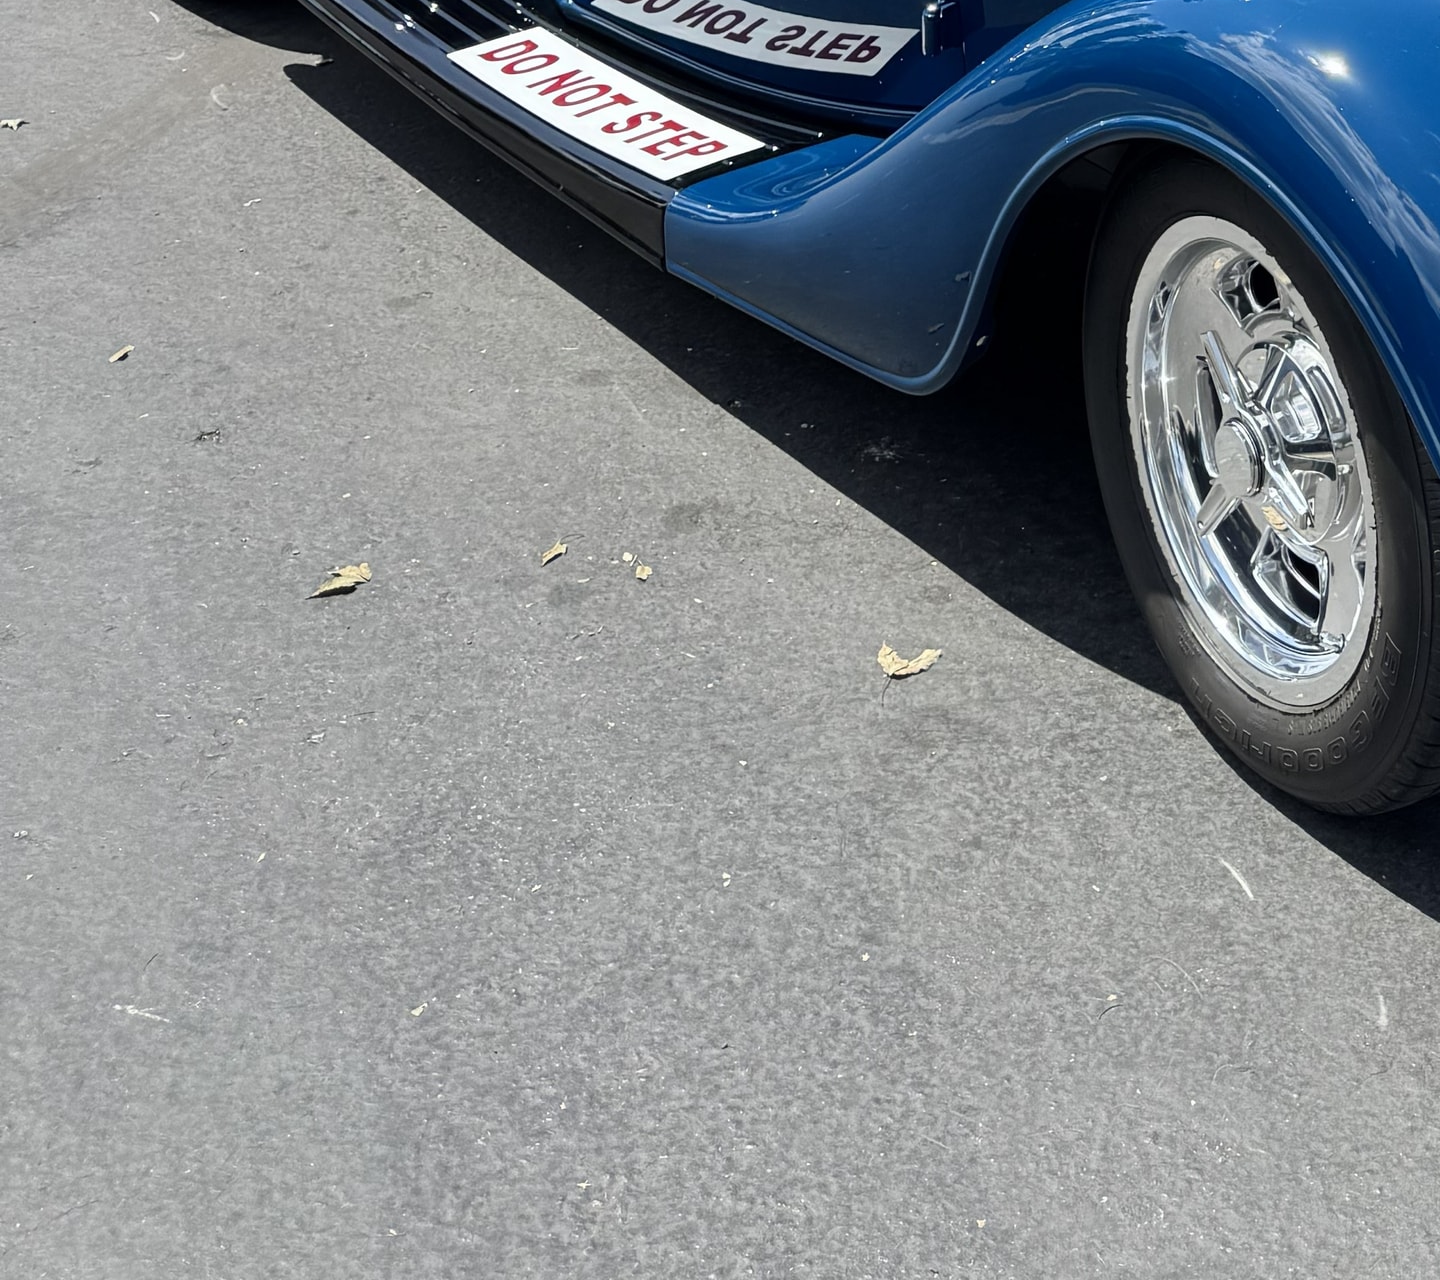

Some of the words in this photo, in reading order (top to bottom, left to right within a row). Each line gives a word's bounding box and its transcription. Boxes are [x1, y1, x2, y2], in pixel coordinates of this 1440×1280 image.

[478, 39, 561, 75] DO
[526, 68, 636, 118] NOT
[605, 110, 728, 162] STEP
